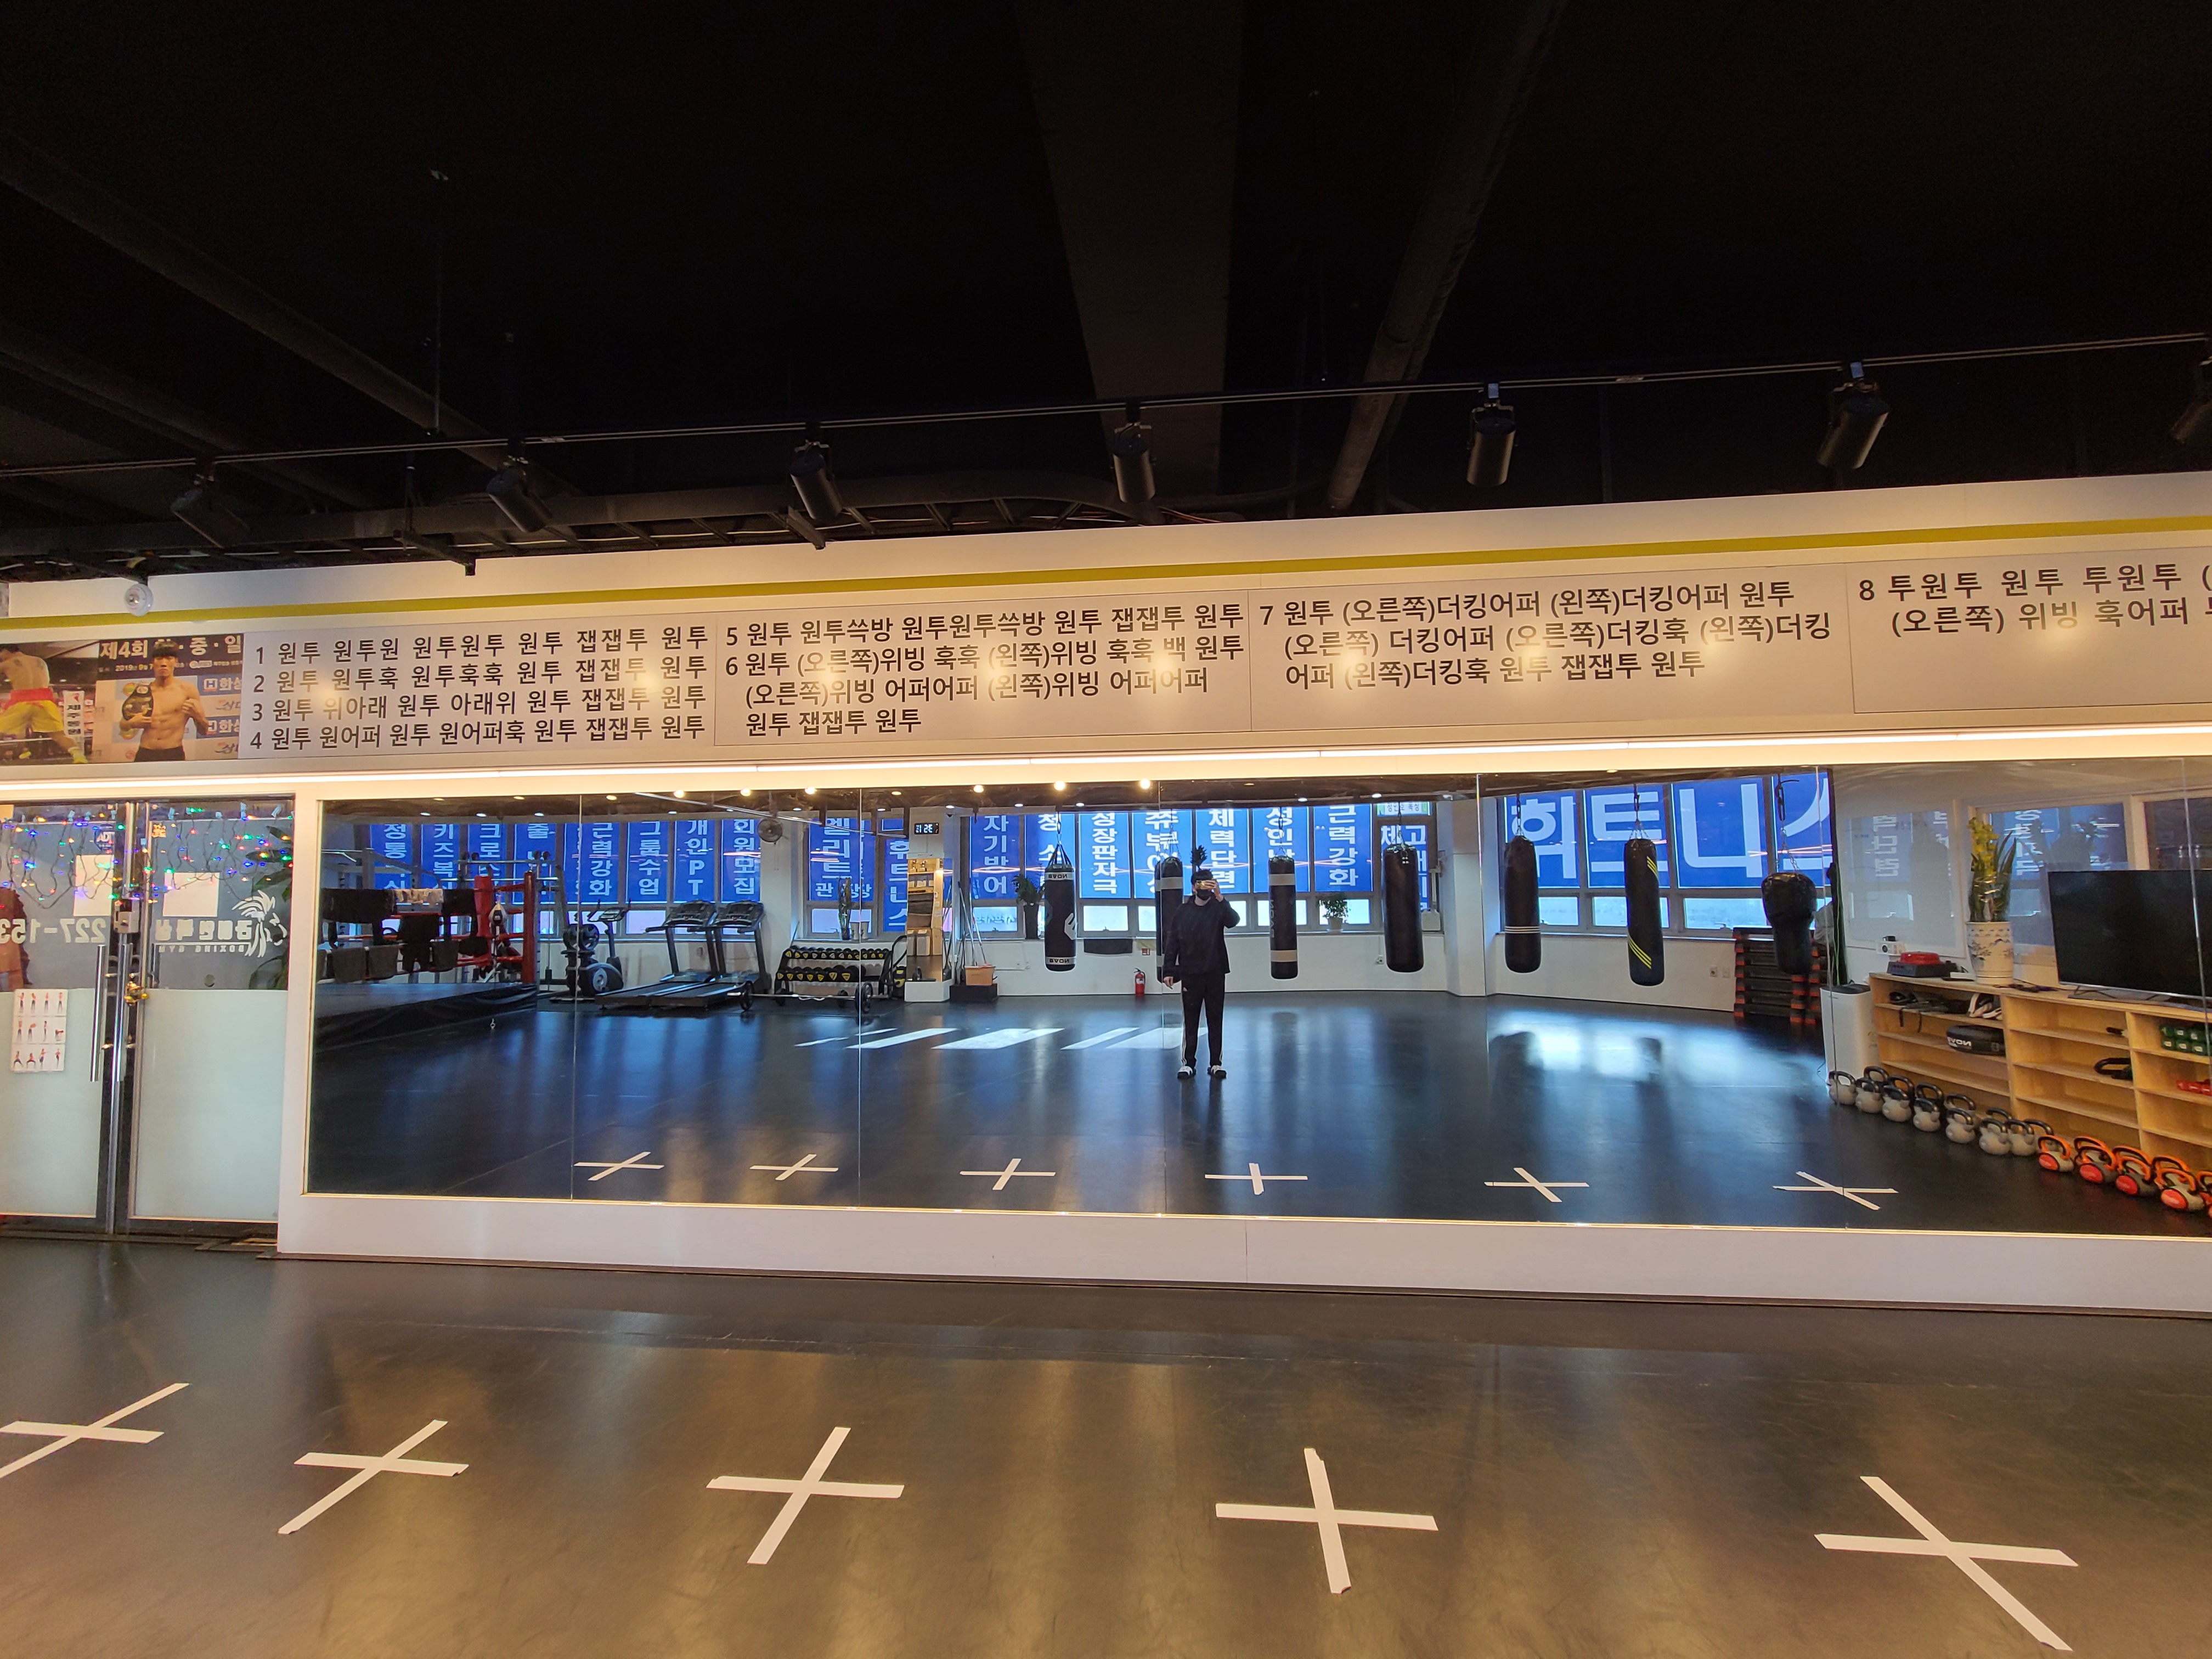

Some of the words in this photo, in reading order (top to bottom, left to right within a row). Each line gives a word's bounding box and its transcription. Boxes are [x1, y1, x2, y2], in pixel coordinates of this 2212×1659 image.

[1259, 605, 1274, 625] 7
[1284, 600, 1334, 627] 원투
[1343, 590, 1541, 627] (오른쪽)더킹어퍼
[1550, 583, 1730, 618] (왼쪽)더킹어퍼
[1739, 580, 1795, 608] 원투
[1859, 579, 1875, 601] 8
[1888, 572, 1983, 602] 투원투
[2001, 568, 2064, 596] 원투
[2083, 563, 2182, 594] 투원투
[726, 627, 738, 646] 5
[747, 621, 792, 647] 원투
[800, 617, 894, 645] 원투쓱방
[901, 610, 1046, 641] 원투원투쓱방
[1054, 609, 1102, 635] 원투
[1111, 606, 1186, 633] 잽잽투
[1194, 603, 1244, 630] 원투
[1285, 629, 1379, 661] (오른쪽)
[1390, 625, 1494, 654] 더킹어퍼
[1506, 617, 1690, 651] (오른쪽)더킹훅
[1700, 612, 1831, 646] (왼쪽)더킹
[1892, 605, 2005, 638] (오른쪽)
[2018, 601, 2079, 630] 위빙
[2094, 597, 2189, 628] 훅어퍼
[100, 640, 148, 659] 제4회
[256, 646, 264, 664] 1
[278, 641, 321, 665] 원투
[333, 637, 399, 663] 원투원
[413, 633, 505, 659] 원투원투
[518, 631, 563, 656] 원투
[576, 628, 648, 653] 잽잽투
[661, 625, 708, 651] 원투
[725, 656, 738, 676] 6
[746, 651, 791, 677] 원투
[797, 646, 926, 677] (오른쪽)위빙
[934, 644, 980, 670] 훅훅
[988, 640, 1097, 670] (왼쪽)위빙
[1107, 637, 1155, 664] 훅훅
[1163, 636, 1186, 662] 백
[1195, 634, 1244, 661] 원투
[253, 675, 264, 693] 2
[276, 670, 319, 693] 원투
[331, 666, 399, 691] 원투훅
[411, 662, 504, 689] 원투훅훅
[517, 661, 562, 685] 원투
[575, 657, 647, 682] 잽잽투
[660, 656, 707, 680] 원투
[746, 678, 875, 709] (오른쪽)위빙
[885, 675, 978, 703] 어퍼어퍼
[988, 670, 1099, 701] (왼쪽)위빙
[1110, 667, 1208, 695] 어퍼어퍼
[1286, 662, 1335, 691] 어퍼
[1344, 657, 1491, 691] (왼쪽)더킹훅
[1499, 656, 1552, 682] 원투
[1561, 652, 1642, 680] 잽잽투
[1651, 651, 1706, 678] 원투
[252, 703, 263, 721] 3
[273, 698, 314, 722] 원투
[323, 695, 387, 721] 위아래
[398, 693, 440, 718] 원투
[450, 691, 516, 716] 아래위
[527, 689, 571, 714] 원투
[582, 687, 650, 712] 잽잽투
[661, 685, 706, 710] 원투
[746, 712, 791, 737] 원투
[799, 710, 868, 735] 잽잽투
[875, 708, 922, 733] 원투
[250, 731, 262, 750] 4
[272, 727, 312, 751] 원투
[319, 724, 381, 749] 원어퍼
[390, 723, 431, 747] 원투
[439, 720, 526, 746] 원어퍼훅
[534, 719, 577, 743] 원투
[586, 716, 652, 741] 잽잽투
[661, 715, 706, 740] 원투
[589, 823, 613, 896] 근력강화
[639, 821, 661, 895] 그룹수업
[733, 819, 755, 895] 회원모집
[984, 815, 1009, 895] 자기방어
[1328, 805, 1359, 887] 근력강화
